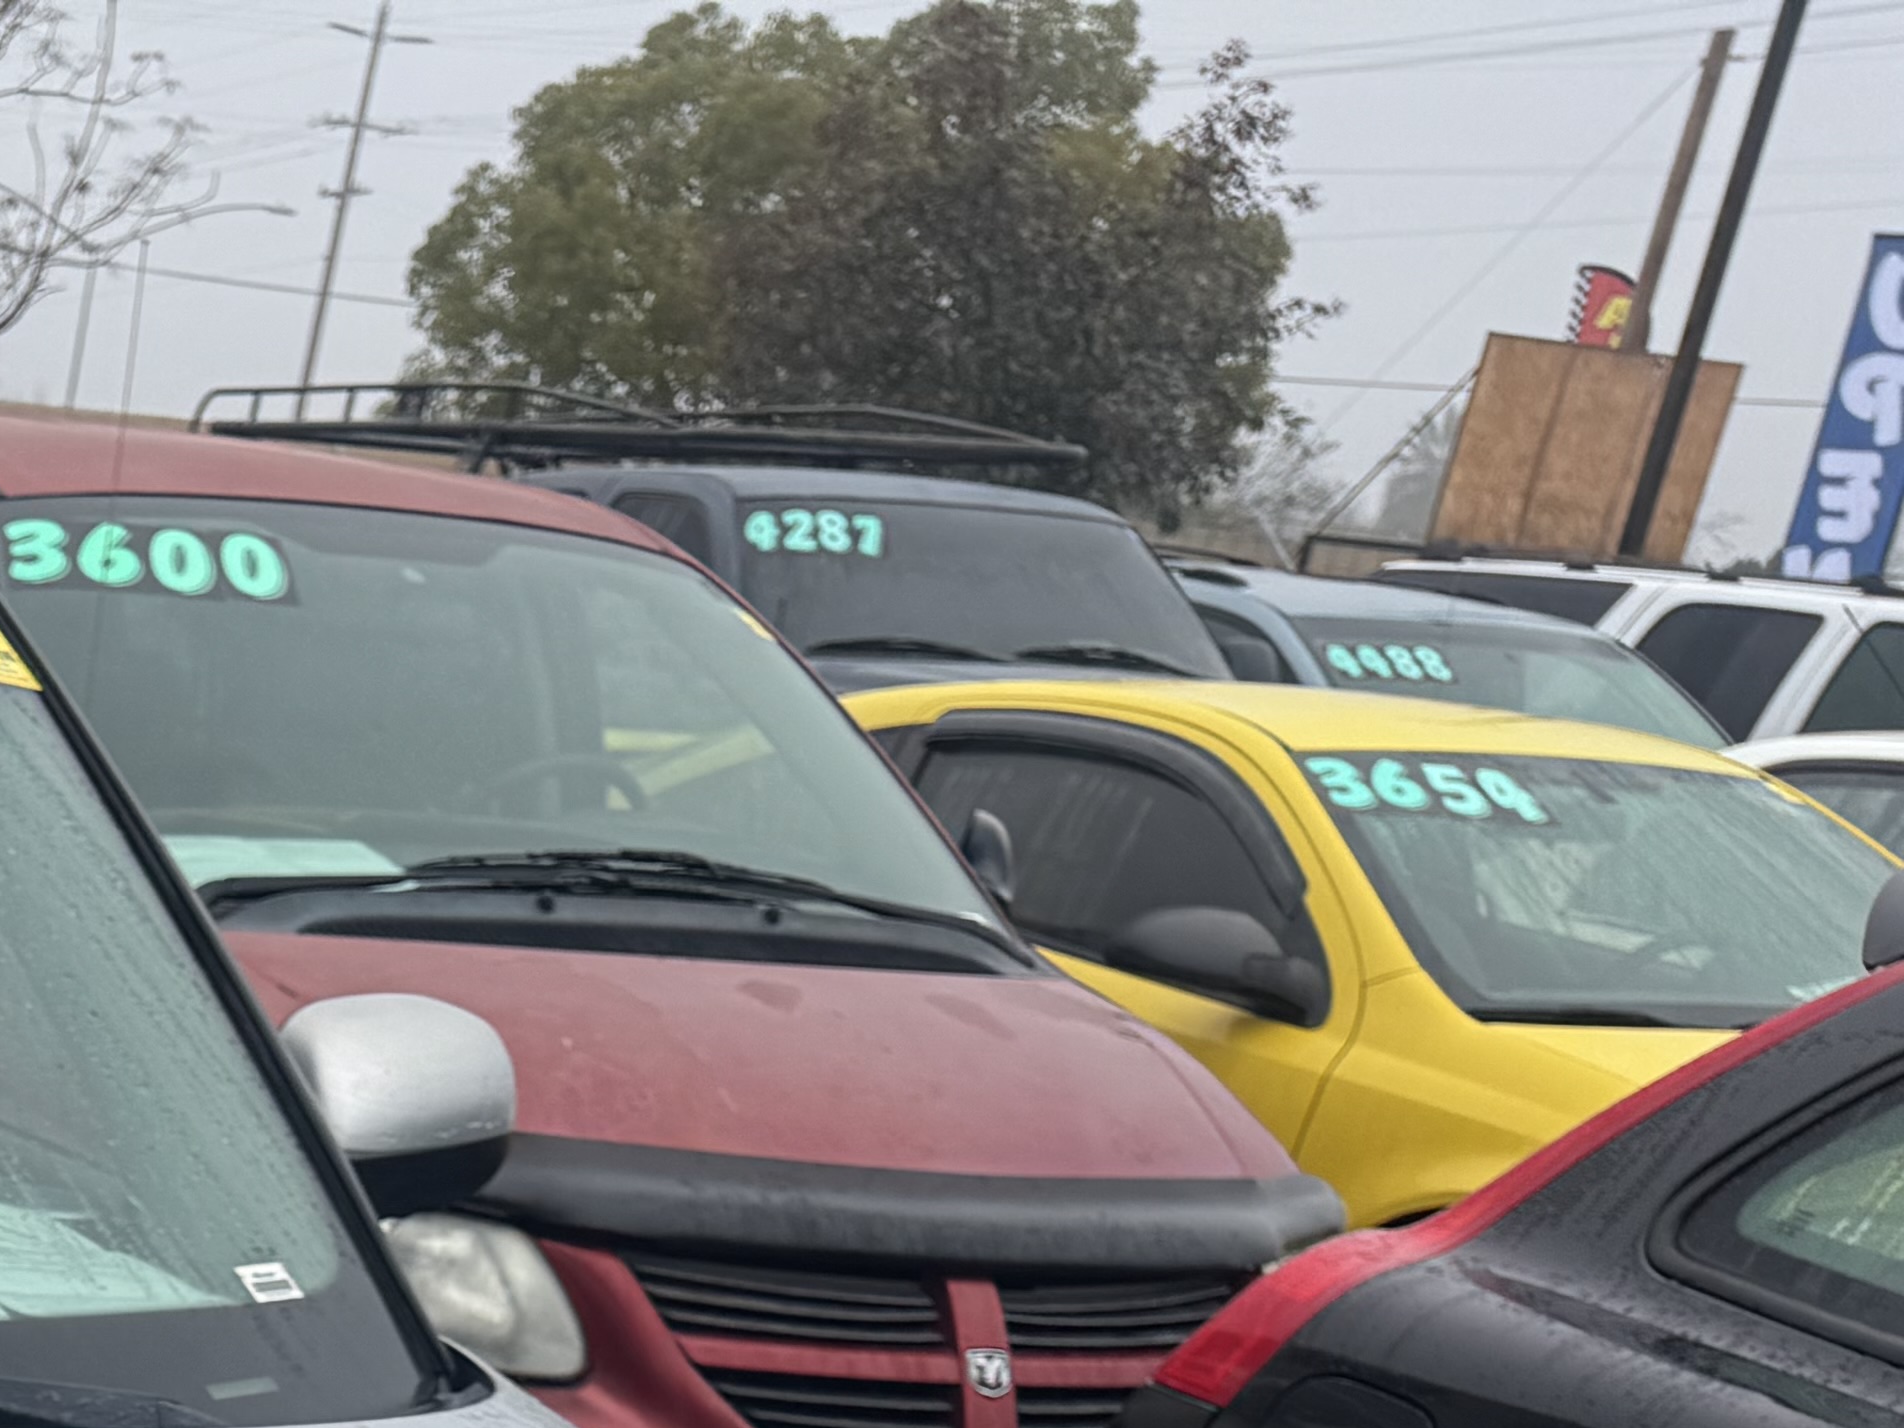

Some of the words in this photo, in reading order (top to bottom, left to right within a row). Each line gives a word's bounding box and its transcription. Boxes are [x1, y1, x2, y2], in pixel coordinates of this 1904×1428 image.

[3, 517, 289, 599] 3600
[744, 508, 883, 557] 4287
[1303, 756, 1549, 825] 3654
